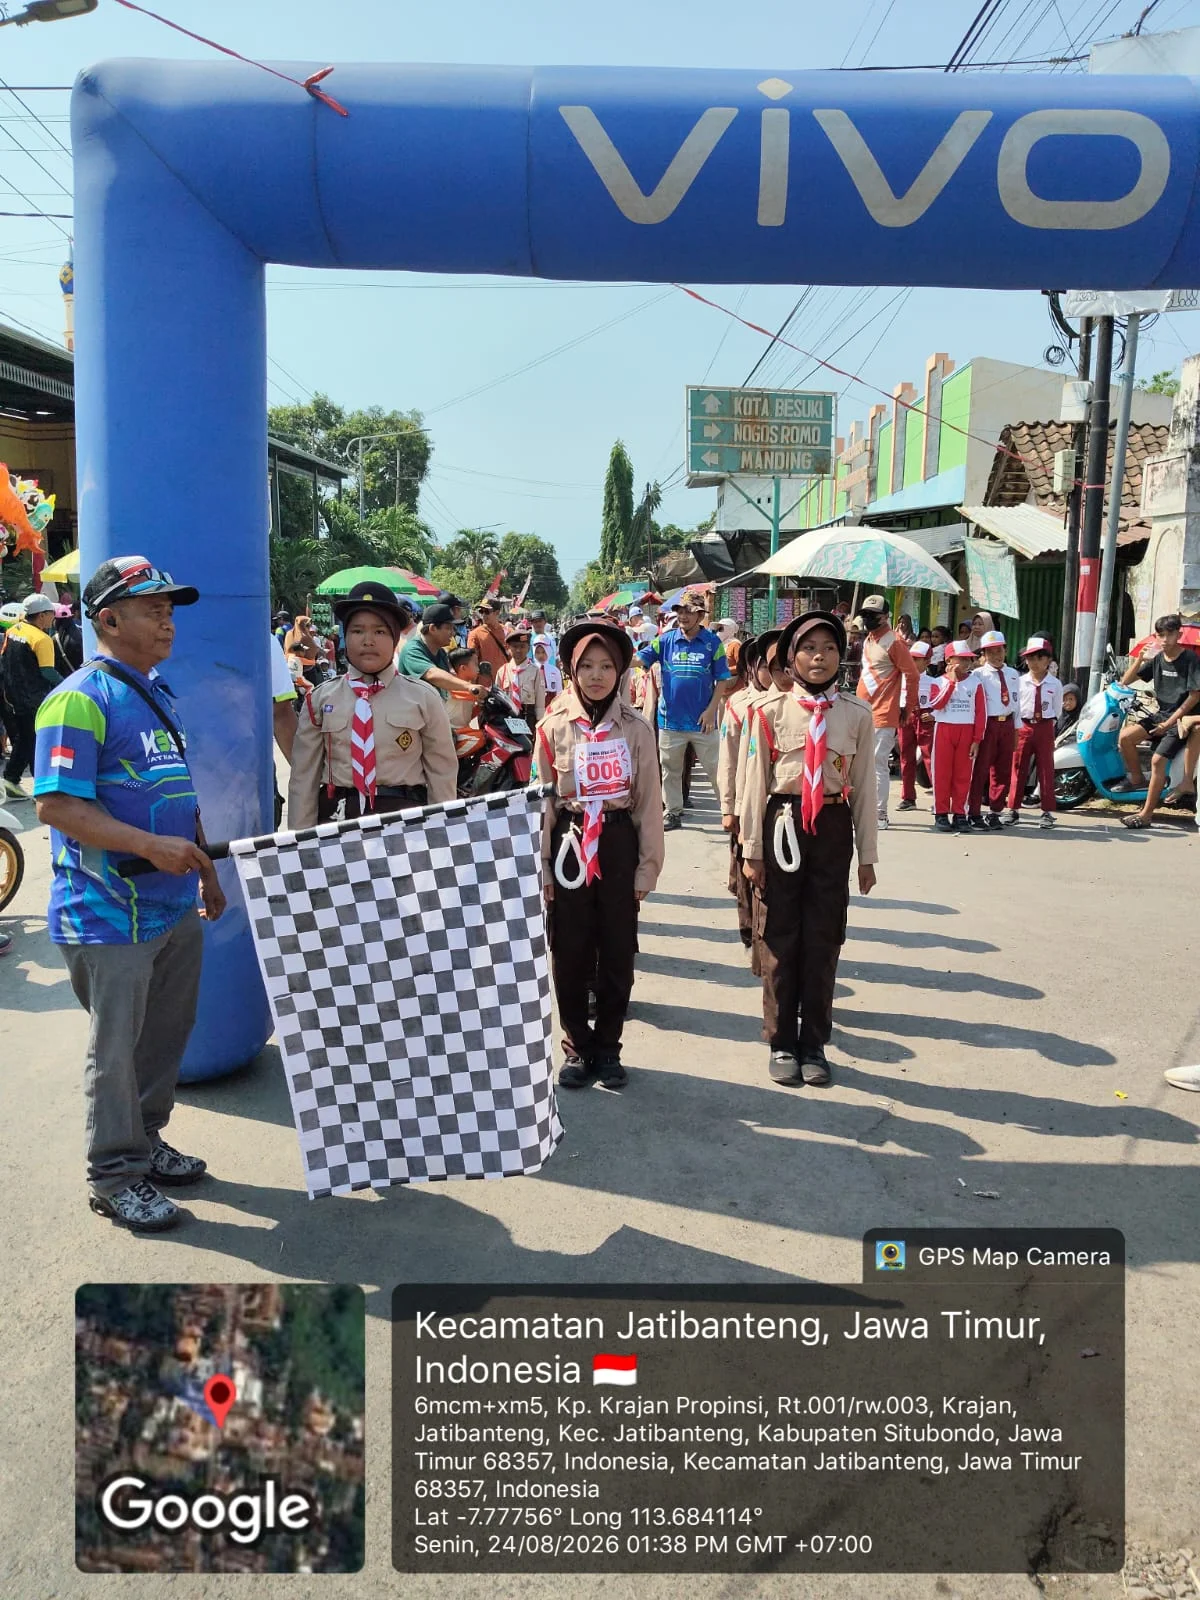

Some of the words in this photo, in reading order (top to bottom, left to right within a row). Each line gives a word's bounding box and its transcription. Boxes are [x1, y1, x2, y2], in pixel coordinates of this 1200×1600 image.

[558, 77, 1171, 229] vivo
[775, 398, 823, 418] BESUKI
[741, 451, 812, 470] MANDING
[587, 759, 622, 781] 006
